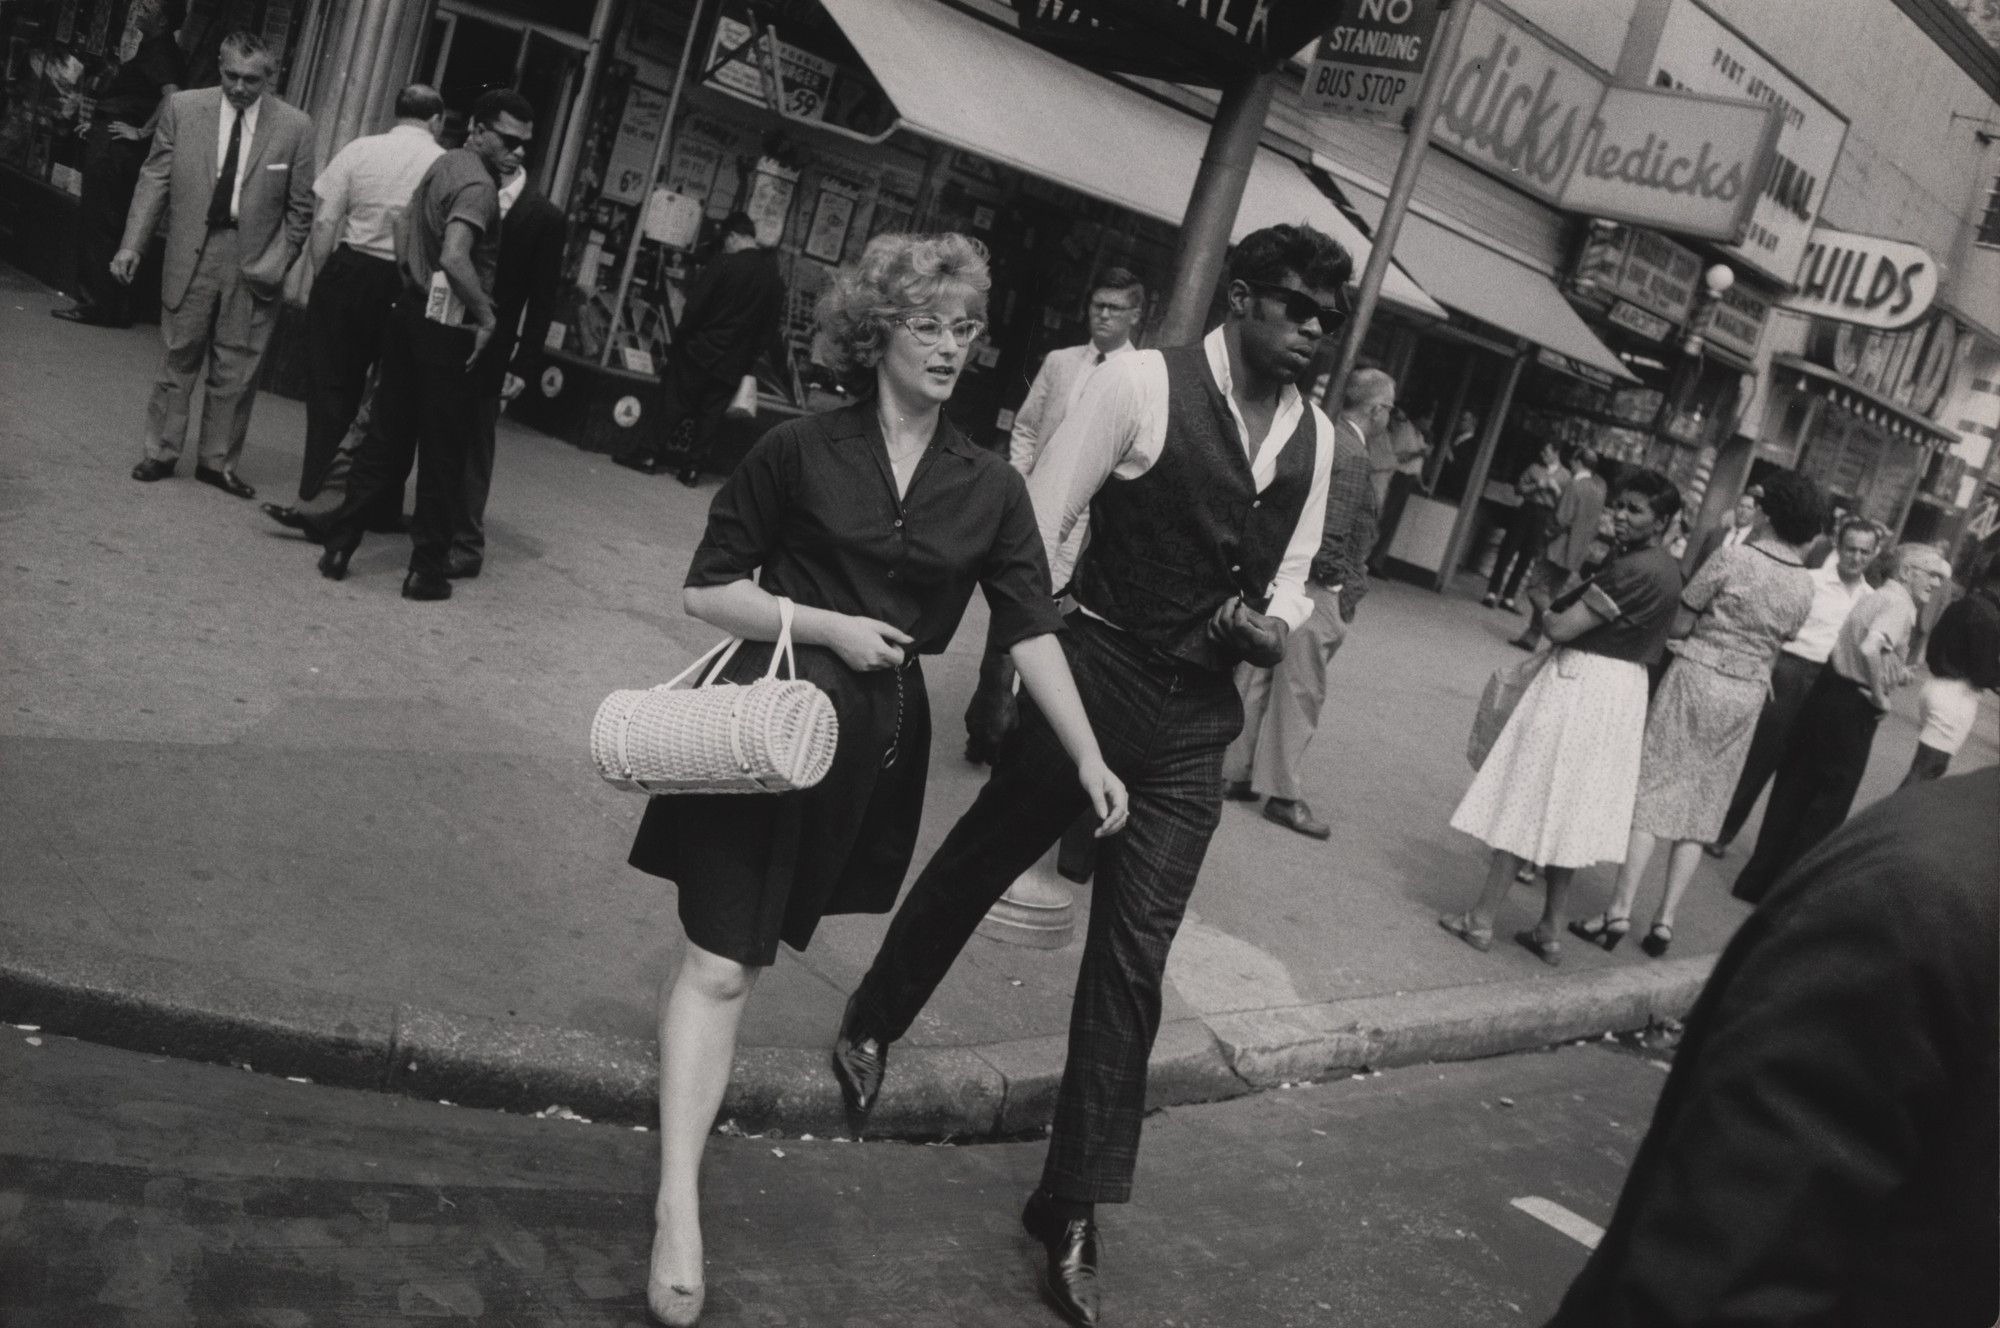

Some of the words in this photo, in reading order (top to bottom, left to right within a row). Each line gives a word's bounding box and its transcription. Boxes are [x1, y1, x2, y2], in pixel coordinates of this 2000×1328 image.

[1358, 0, 1413, 24] NO
[1329, 25, 1421, 62] STANDING
[1712, 48, 1745, 85] PORT
[1316, 66, 1355, 98] BUS
[1357, 73, 1406, 106] STOP
[1440, 33, 1579, 184] dicks
[1803, 242, 1924, 316] HILDS
